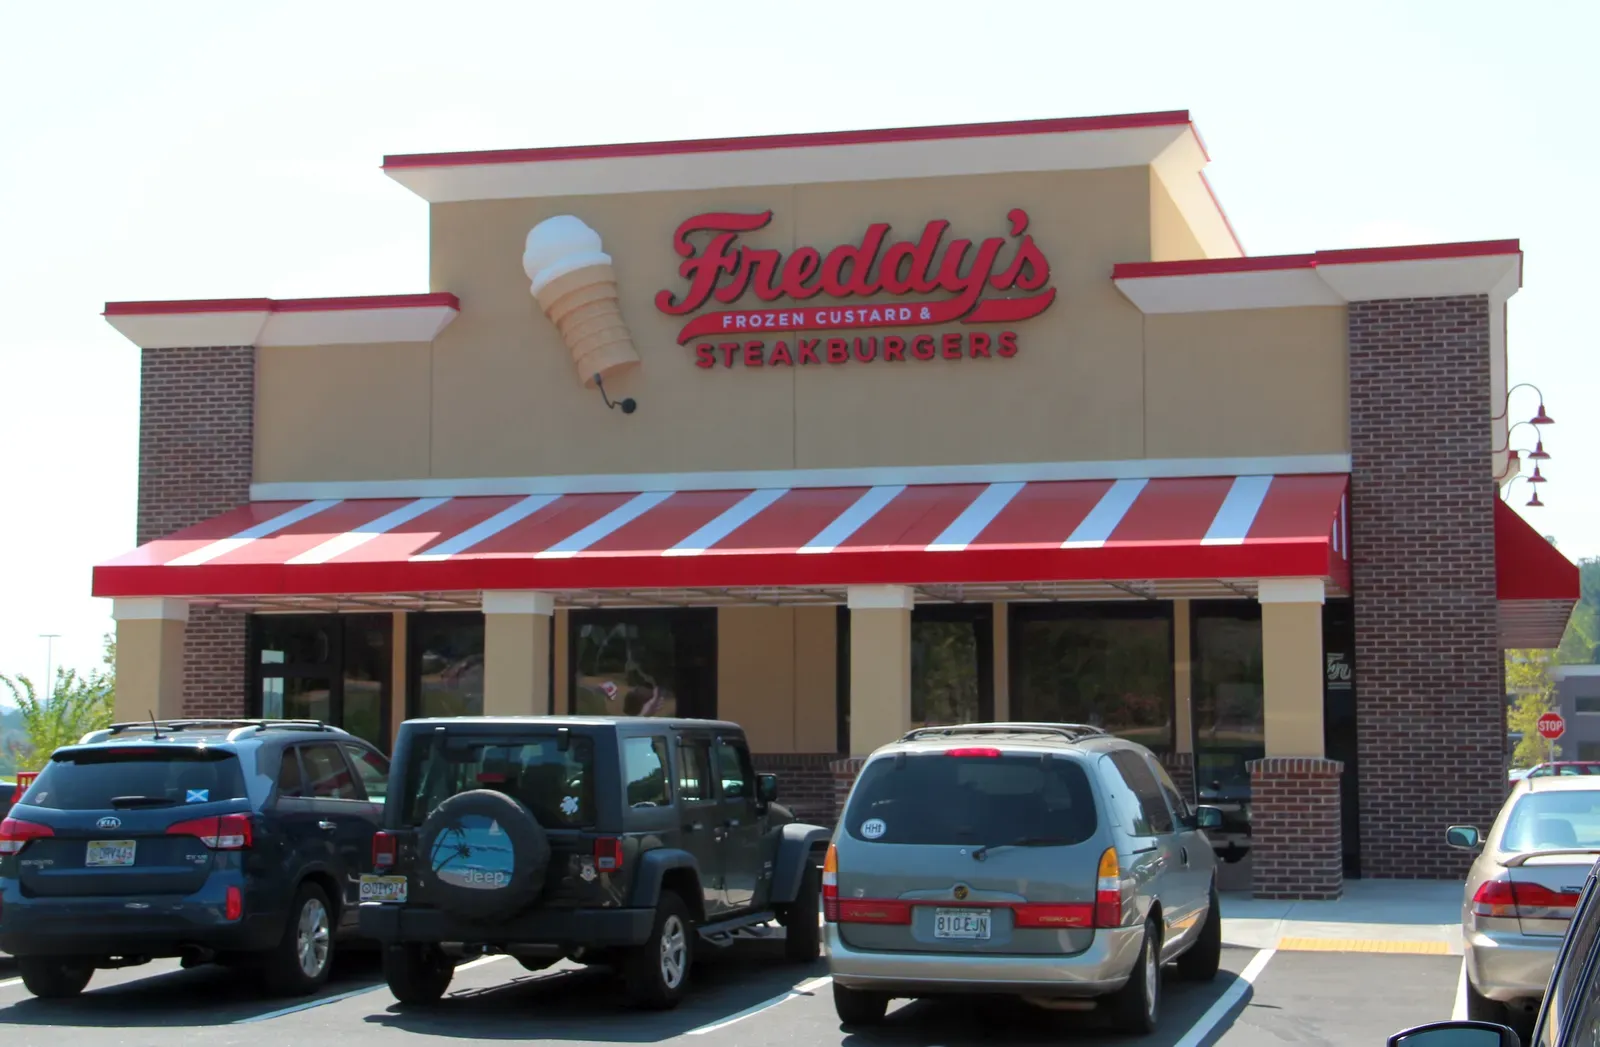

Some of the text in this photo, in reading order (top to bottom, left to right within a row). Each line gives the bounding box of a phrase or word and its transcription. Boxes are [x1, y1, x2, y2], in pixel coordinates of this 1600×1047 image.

[655, 208, 1053, 322] Freddy's
[722, 307, 931, 328] FROZEN CUSTARD &
[695, 331, 1018, 368] STEAKBURGERS
[1539, 720, 1562, 731] STOP
[99, 818, 119, 828] KIA
[464, 868, 504, 886] Jeep
